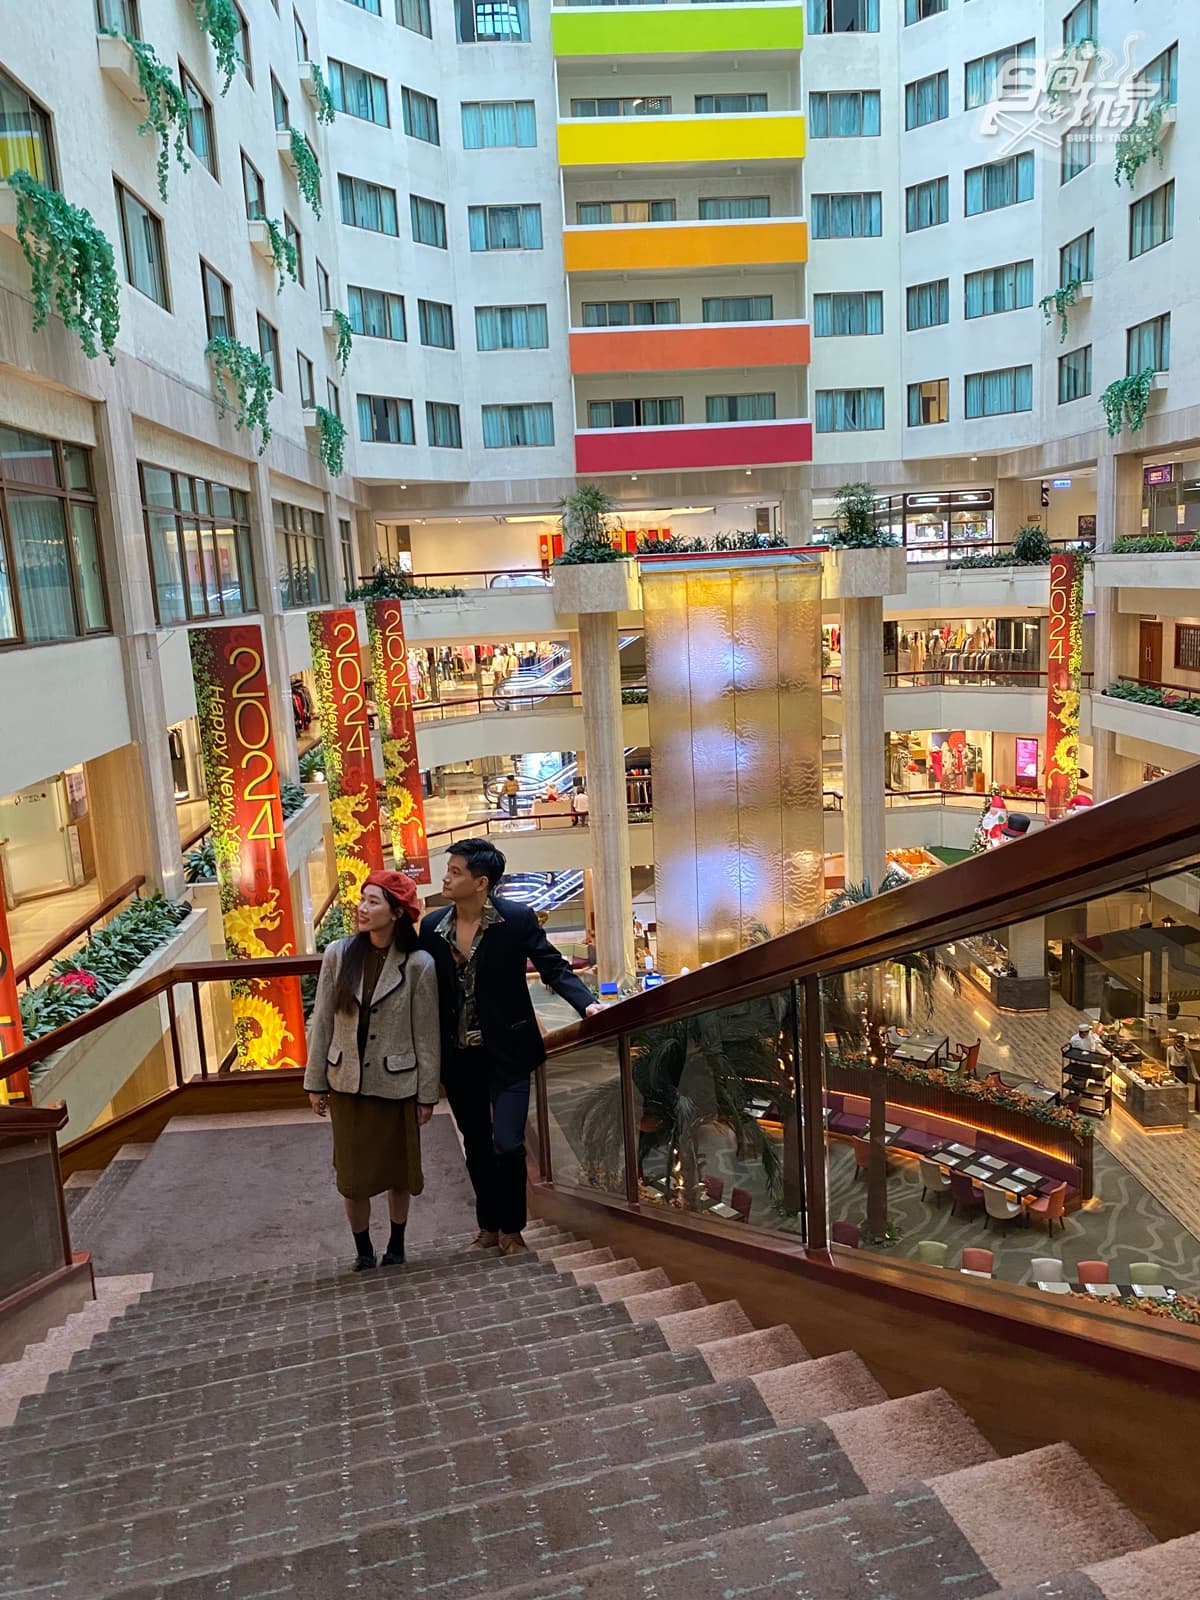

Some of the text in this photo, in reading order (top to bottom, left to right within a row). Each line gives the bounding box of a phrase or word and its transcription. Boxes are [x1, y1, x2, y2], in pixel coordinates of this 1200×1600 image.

[374, 629, 384, 667] Happy
[1048, 564, 1067, 664] 2024
[1068, 582, 1079, 617] Happy
[1069, 621, 1078, 647] New
[334, 623, 370, 758] 2024
[378, 669, 388, 695] New
[384, 609, 411, 711] 2024
[229, 647, 282, 849] 2024
[320, 648, 344, 776] Happy New Year
[209, 685, 242, 877] Happy New Year
